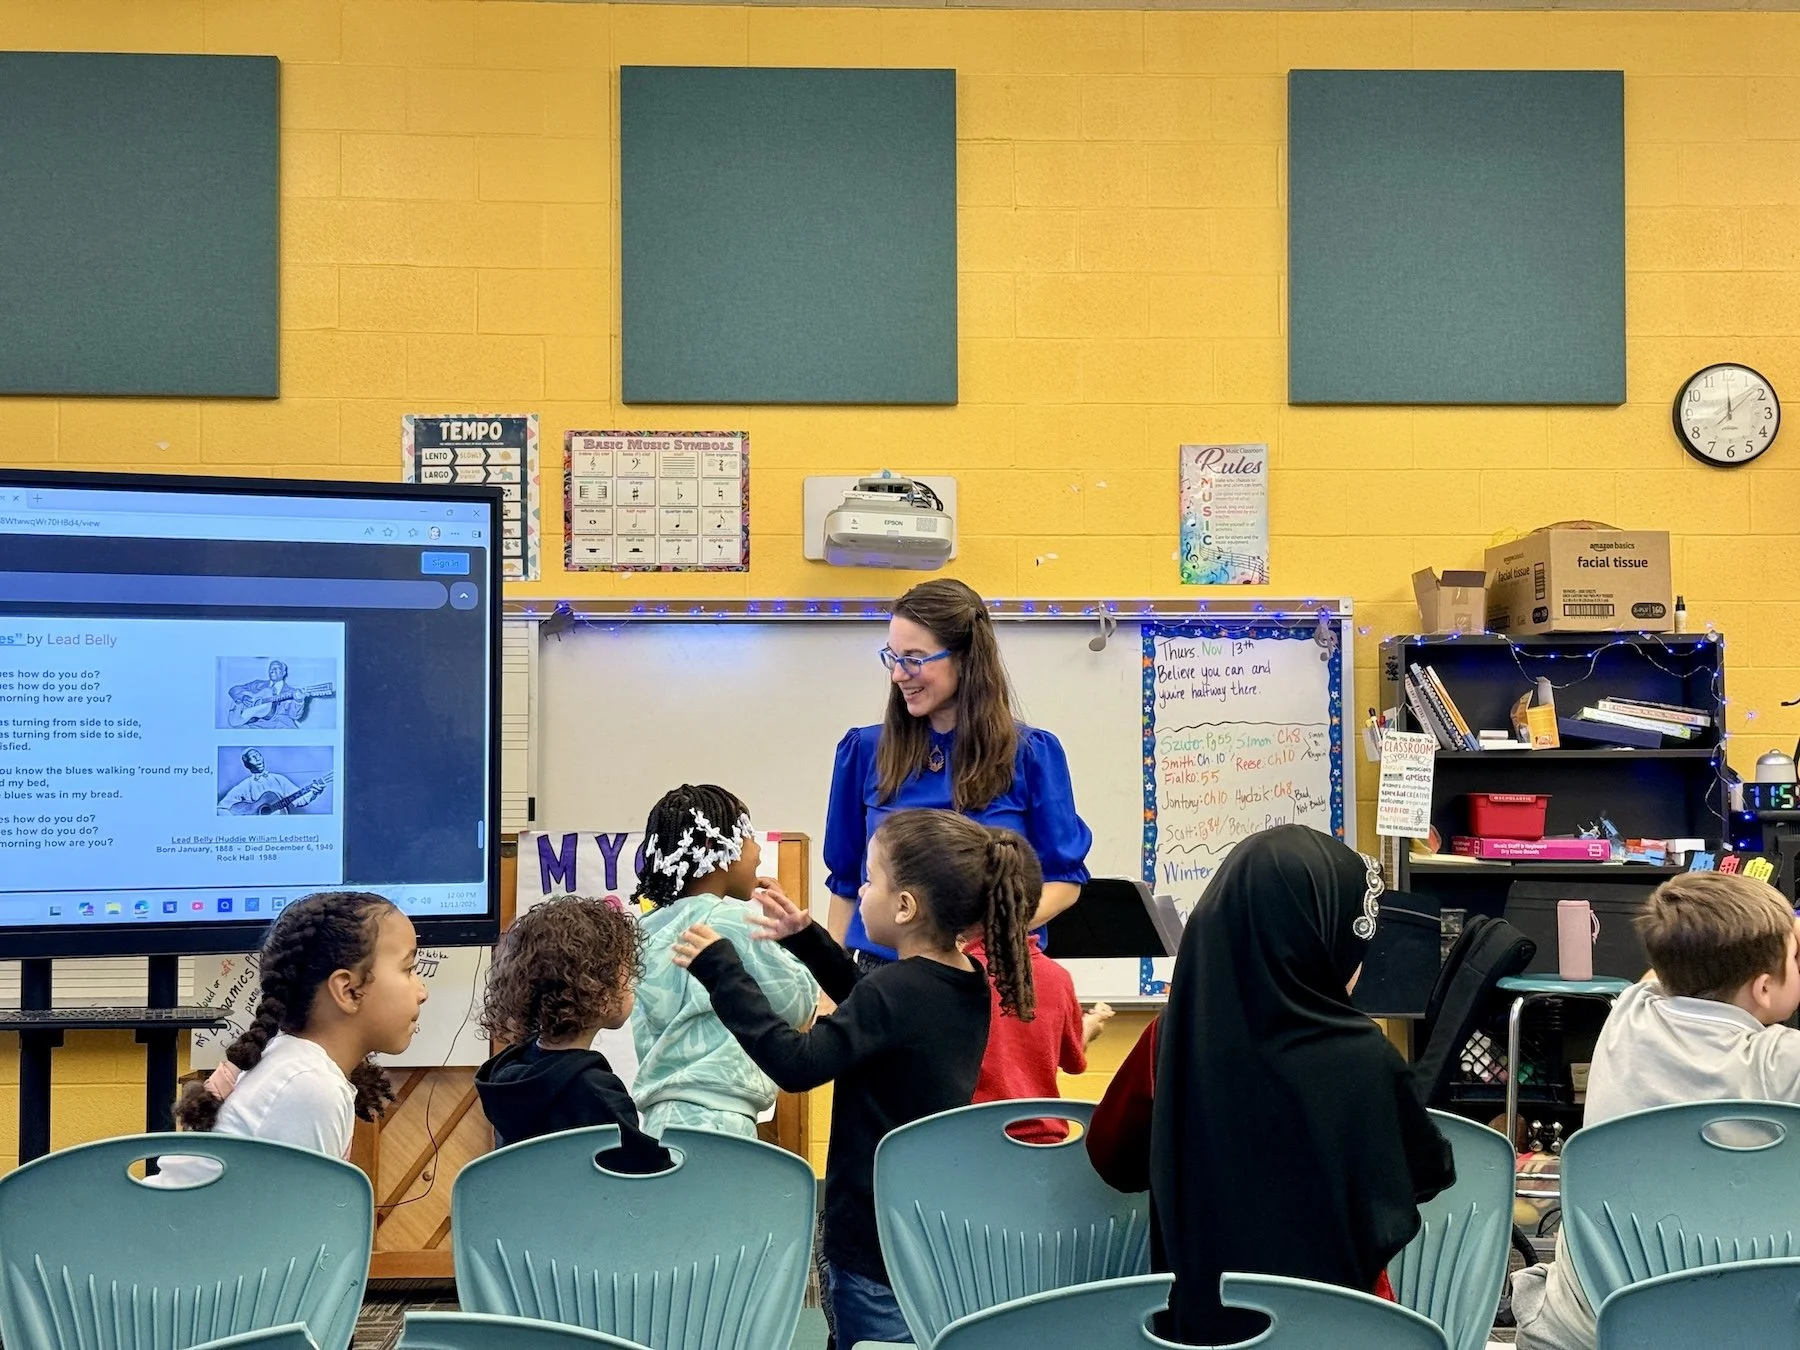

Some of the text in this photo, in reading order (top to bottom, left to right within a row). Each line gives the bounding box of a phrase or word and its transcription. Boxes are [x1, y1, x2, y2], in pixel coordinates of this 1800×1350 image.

[1704, 376, 1714, 388] 11
[1722, 371, 1735, 382] 12
[1744, 376, 1749, 387] 1
[1688, 390, 1701, 403] 10
[1758, 389, 1766, 401] 2
[1686, 409, 1693, 421] 9
[1765, 407, 1773, 420] 3
[440, 422, 503, 441] TEMPO
[1692, 426, 1700, 439] 8
[1759, 426, 1767, 438] 4
[584, 439, 734, 450] BASIC MUSIC SYMBOLS
[1708, 442, 1716, 454] 7
[1745, 441, 1753, 453] 5
[1727, 445, 1735, 458] 6
[1195, 448, 1262, 474] Rules
[424, 471, 449, 479] LARGO
[1590, 542, 1635, 551] amazon basics
[432, 560, 449, 568] Sign
[1577, 556, 1648, 568] facial tissue
[1498, 567, 1530, 582] facial tissue
[27, 634, 117, 648] by Lead Belly
[1158, 638, 1254, 661] Thurs. Nov 13th
[18, 670, 100, 680] how do you do?
[1158, 660, 1271, 686] Believe you can and
[18, 682, 100, 692] how do you do?
[1192, 684, 1226, 702] halfway
[1231, 682, 1261, 696] there.
[43, 694, 65, 702] how
[86, 694, 112, 704] you?
[13, 718, 142, 729] turning from side to side,
[13, 730, 142, 741] turning from side to side,
[1385, 742, 1433, 755] CLASSROOM
[1162, 755, 1196, 771] Smith:
[1217, 753, 1225, 764] 10
[1236, 757, 1265, 772] Reese:
[16, 766, 44, 775] know
[46, 766, 62, 775] the
[66, 766, 93, 775] blues
[96, 766, 135, 776] walking
[138, 766, 171, 775] 'round
[174, 768, 189, 776] my
[192, 766, 214, 776] bed,
[1165, 769, 1220, 786] Fialko: 55
[1406, 774, 1431, 783] artists
[8, 779, 49, 789] my bed,
[5, 791, 33, 799] blues
[60, 791, 69, 799] in
[72, 792, 87, 801] my
[90, 790, 123, 799] bread.
[1407, 791, 1430, 800] CREATIVE
[1297, 796, 1327, 815] Not Buddy
[14, 814, 95, 825] how do you do?
[16, 826, 99, 837] how do you do?
[44, 839, 66, 847] how
[88, 838, 113, 849] you?
[194, 836, 213, 844] Belly
[280, 835, 320, 843] Ledbetter)
[178, 846, 213, 854] January,
[265, 844, 304, 852] December
[240, 854, 254, 862] Hall
[1164, 860, 1214, 884] Winter
[214, 980, 220, 989] or
[221, 959, 235, 977] soft
